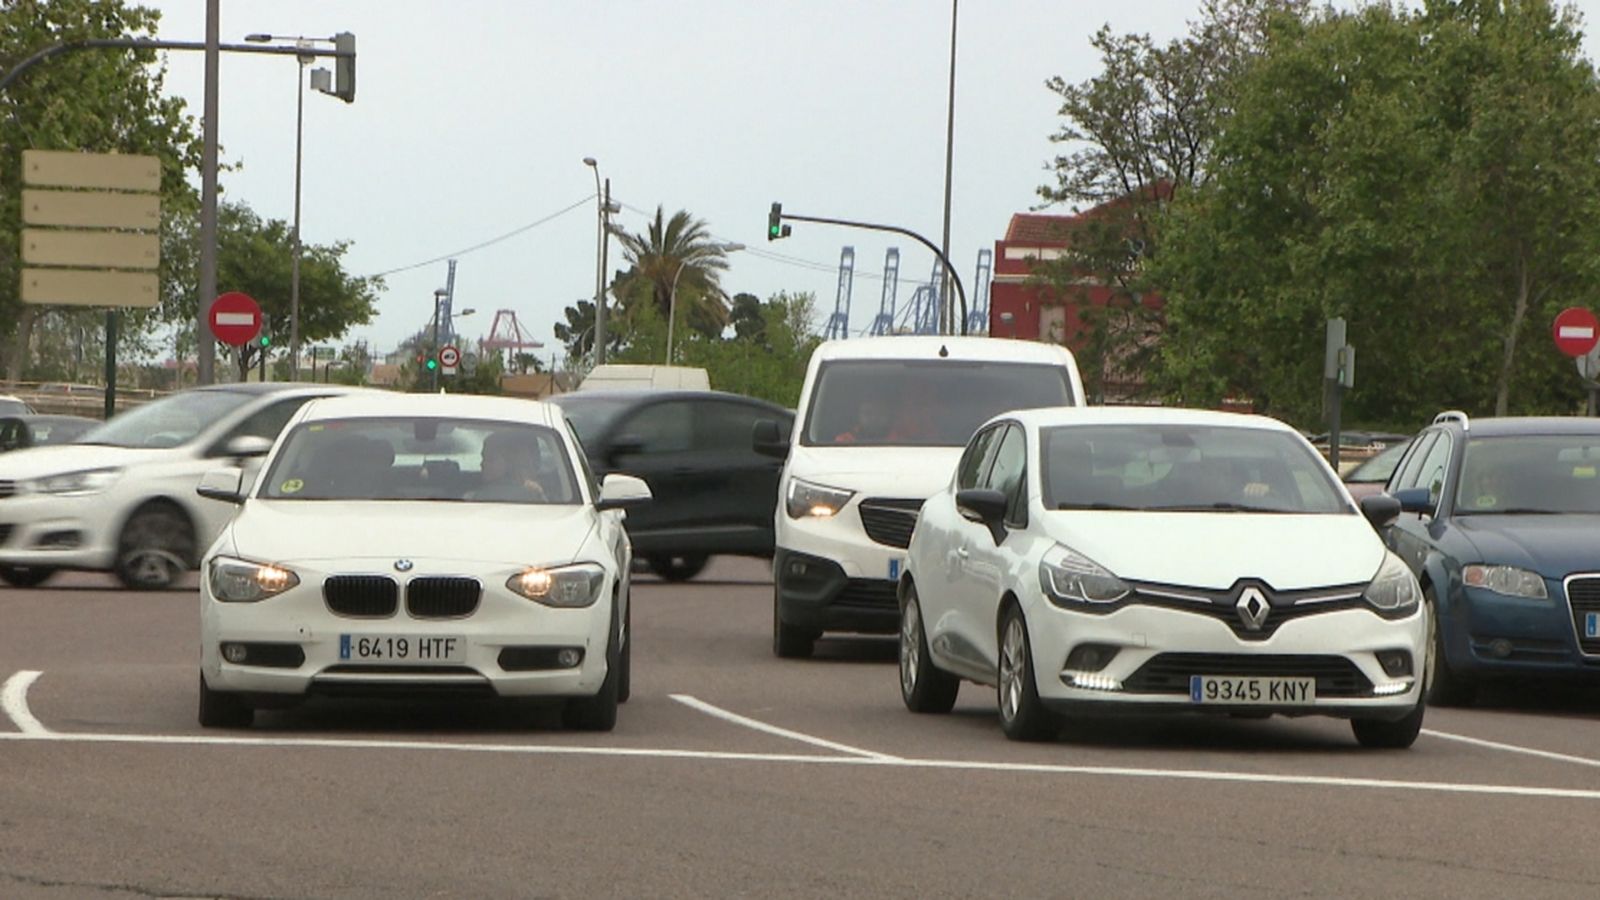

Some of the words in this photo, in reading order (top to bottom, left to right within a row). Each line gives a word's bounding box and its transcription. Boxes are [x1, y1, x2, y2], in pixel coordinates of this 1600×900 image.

[358, 637, 409, 658] 6419
[418, 637, 457, 659] HTF
[1205, 679, 1262, 701] 9345
[1269, 680, 1310, 702] KNY
